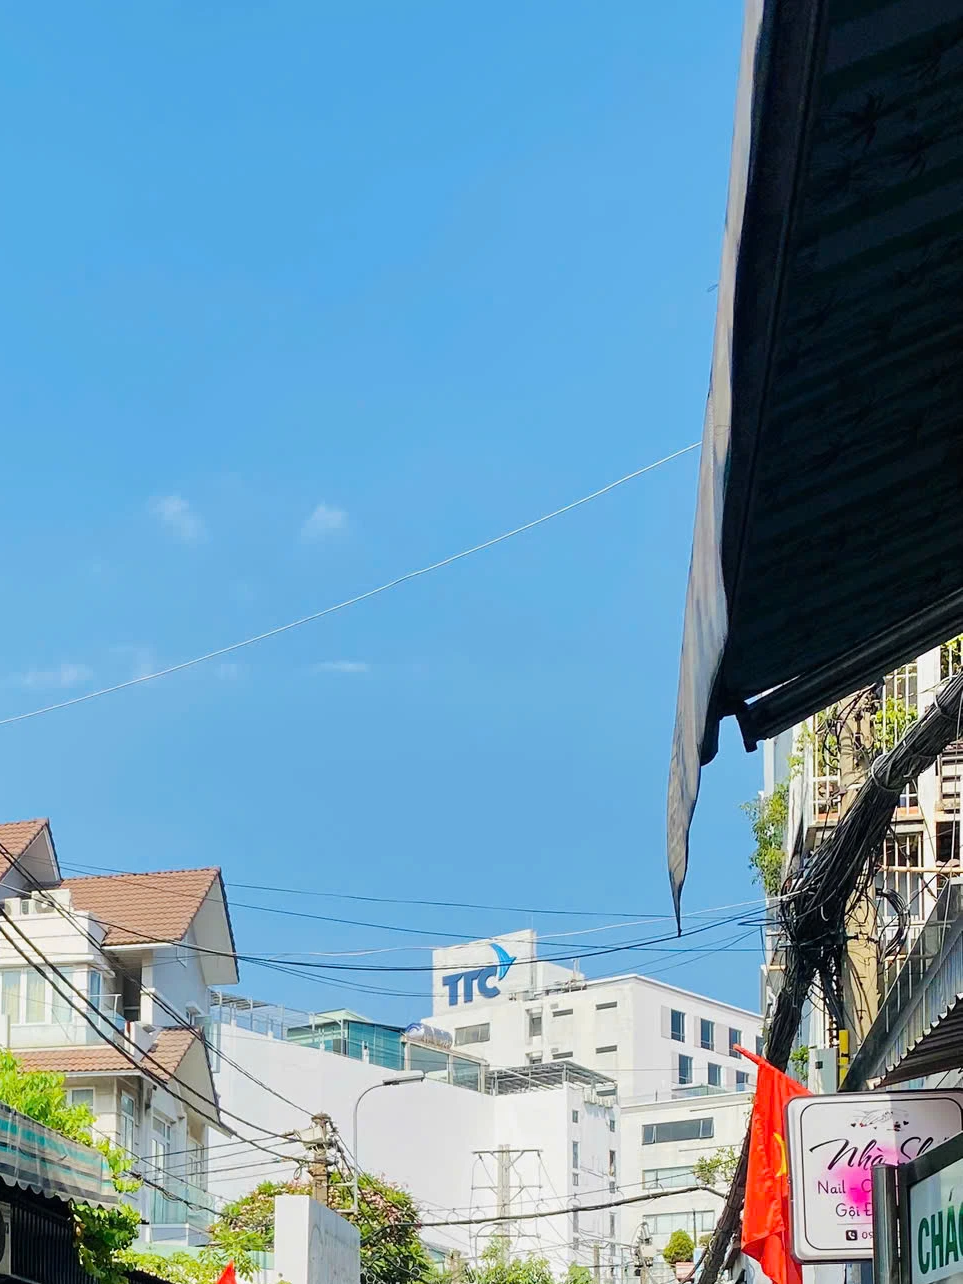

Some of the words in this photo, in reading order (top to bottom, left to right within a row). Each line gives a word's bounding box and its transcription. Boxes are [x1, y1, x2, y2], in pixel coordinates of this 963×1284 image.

[442, 965, 501, 1007] TTC
[809, 1138, 886, 1170] Nhà
[817, 1180, 846, 1195] Nail
[836, 1202, 860, 1219] Gội
